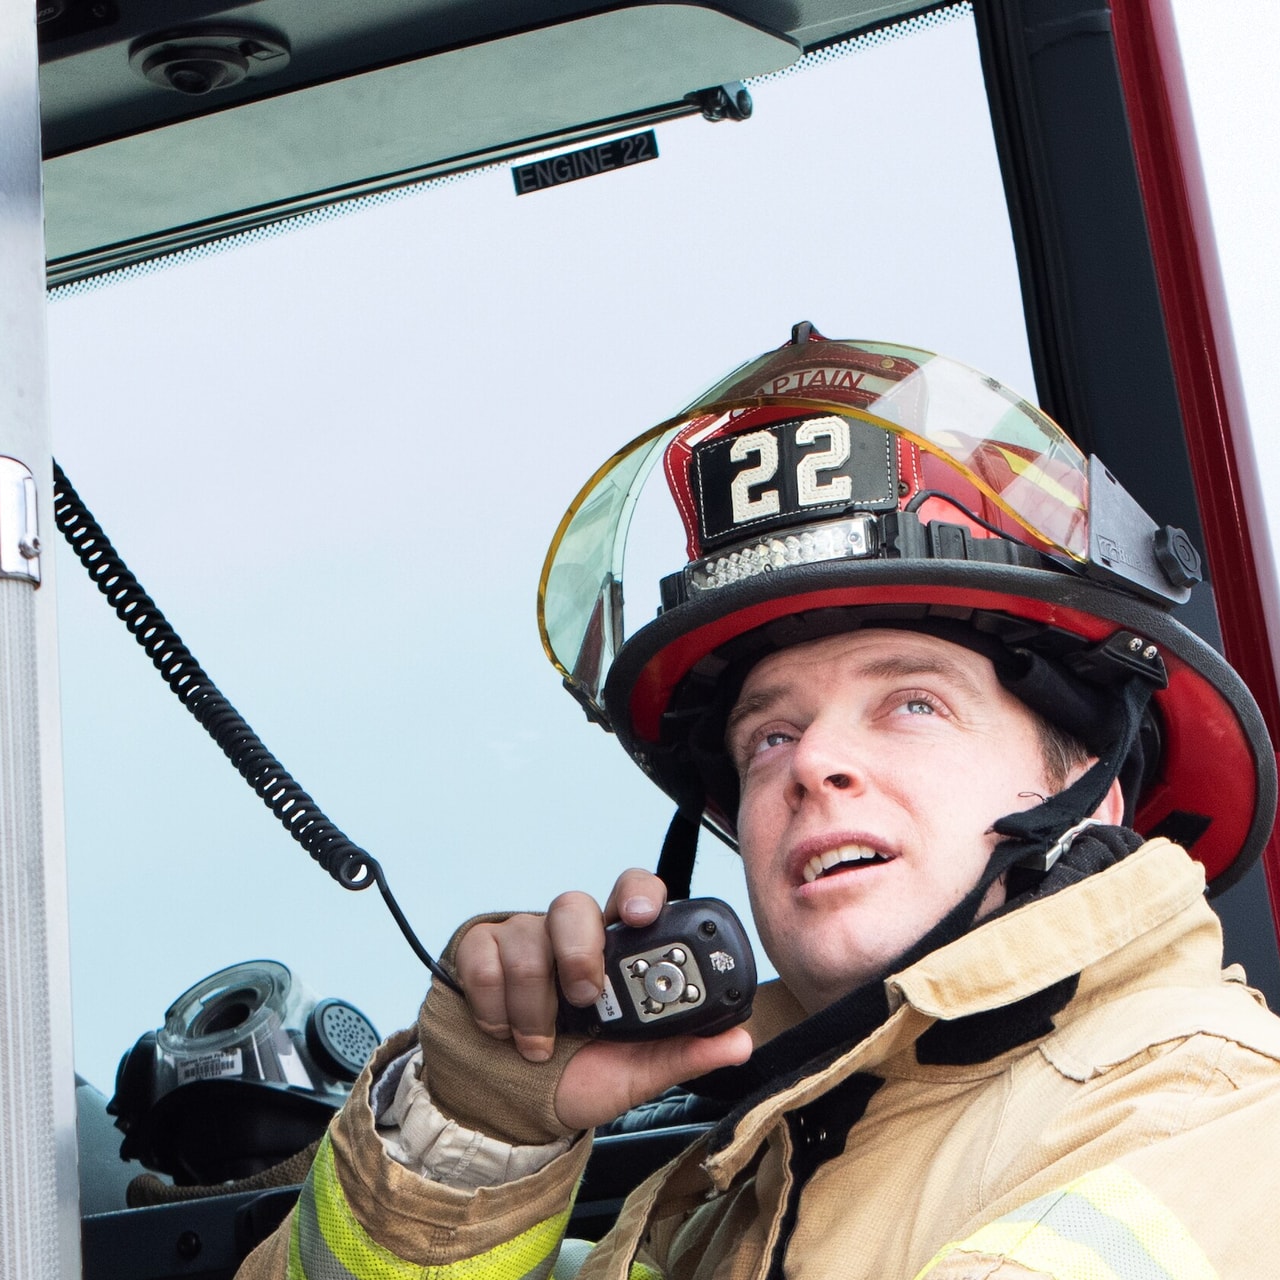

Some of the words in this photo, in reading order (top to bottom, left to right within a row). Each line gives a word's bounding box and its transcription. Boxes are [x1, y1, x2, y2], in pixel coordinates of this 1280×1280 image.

[519, 143, 617, 192] ENGINE
[622, 134, 653, 165] 22
[729, 415, 853, 524] 22
